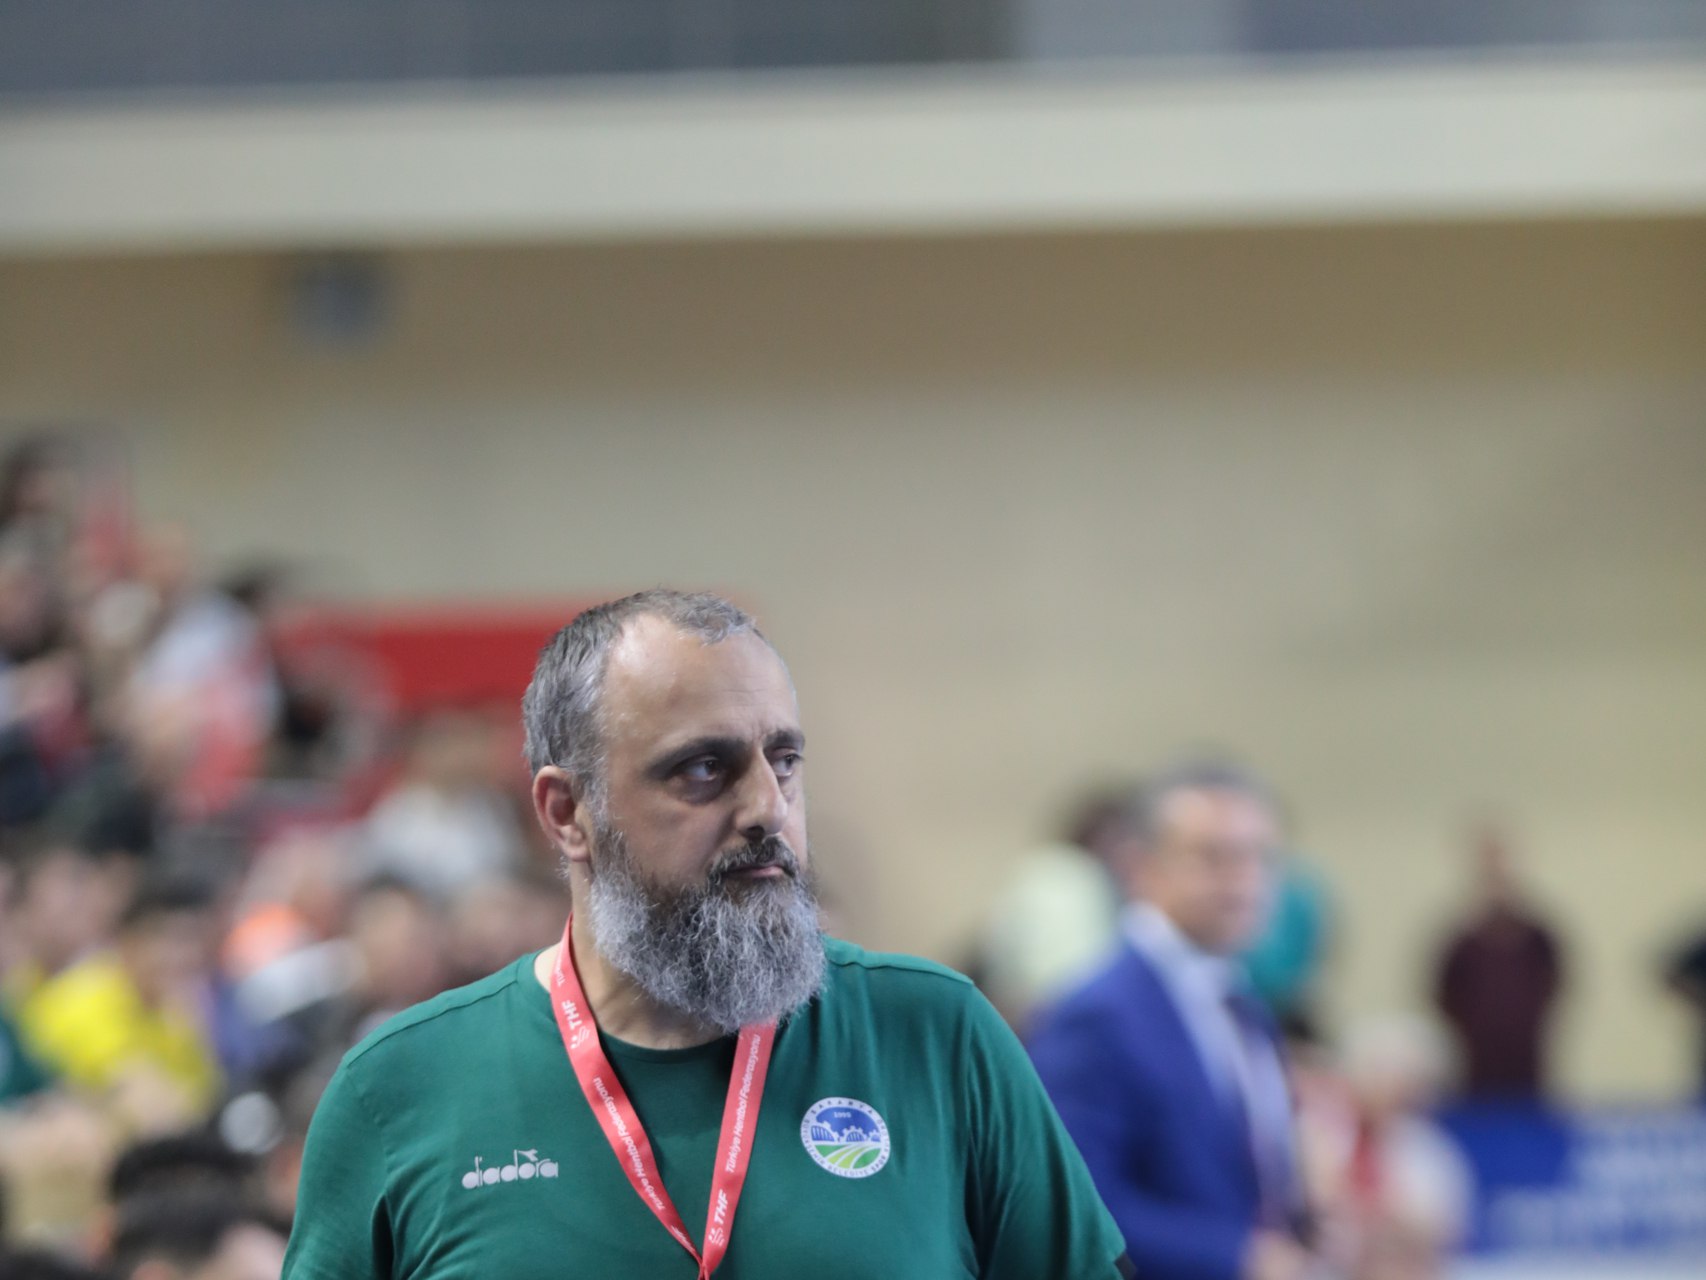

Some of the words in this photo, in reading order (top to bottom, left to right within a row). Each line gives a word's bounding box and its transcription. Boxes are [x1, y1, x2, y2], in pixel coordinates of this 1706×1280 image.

[561, 999, 583, 1031] THF
[739, 1033, 761, 1100] Federasyonu
[592, 1076, 629, 1138] Federasyonu
[733, 1097, 748, 1137] Hentbol
[461, 1148, 560, 1190] diadora
[622, 1135, 646, 1179] Hentbol
[725, 1135, 742, 1174] Türkiye
[714, 1187, 729, 1226] THF
